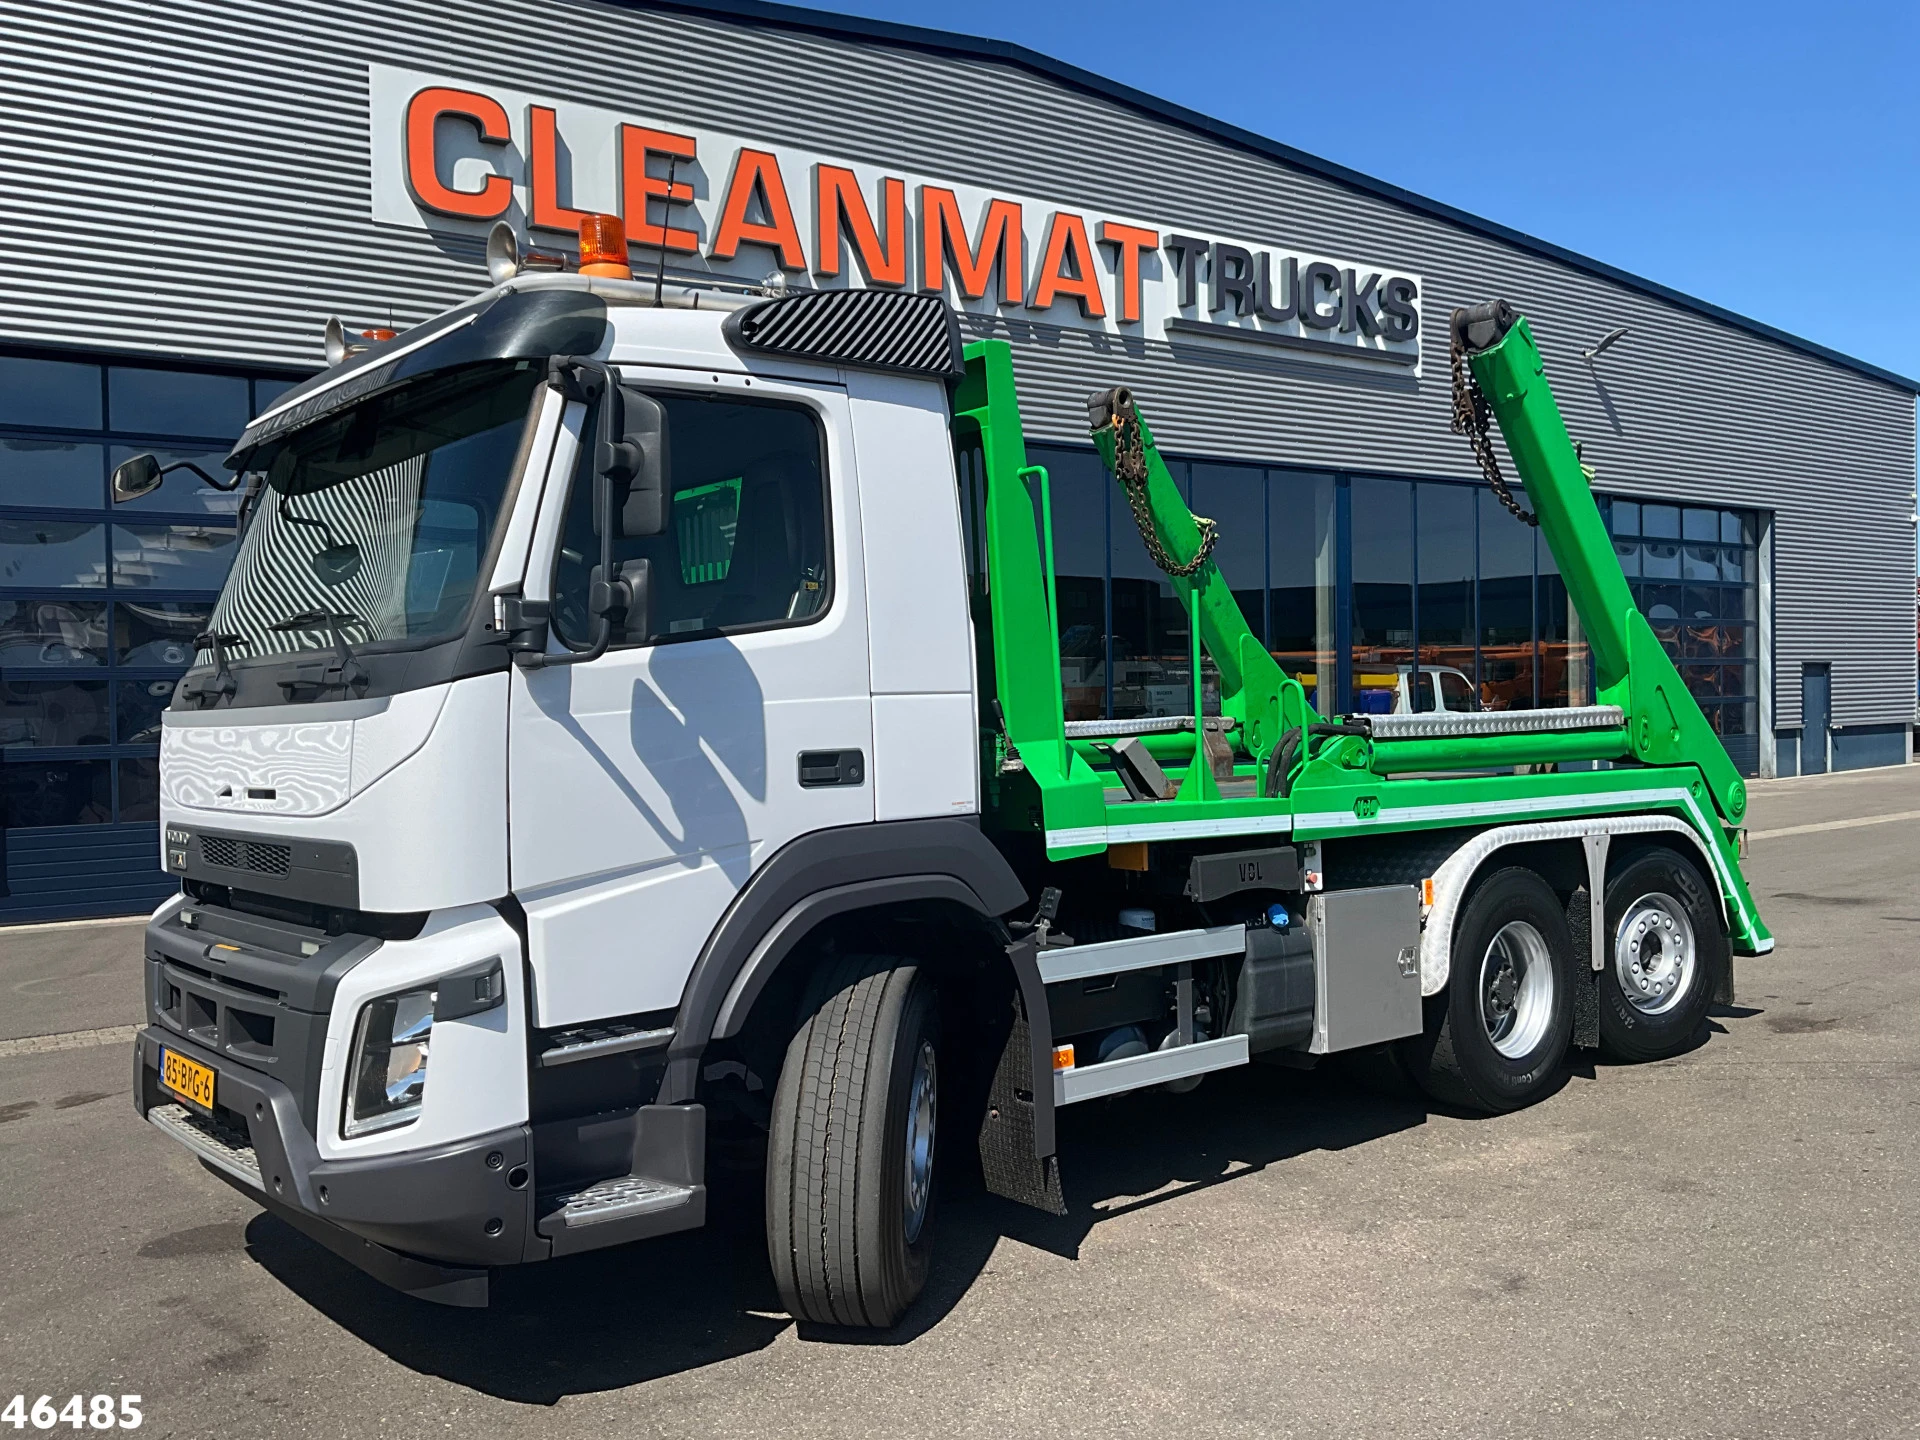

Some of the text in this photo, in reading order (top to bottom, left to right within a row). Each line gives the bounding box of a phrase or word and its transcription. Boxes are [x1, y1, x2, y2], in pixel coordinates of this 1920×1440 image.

[405, 86, 1420, 342] CLEANMAT TRUCKS
[1355, 799, 1376, 818] VDL
[1239, 862, 1263, 882] VDL
[166, 1055, 210, 1102] 85-BPG-6
